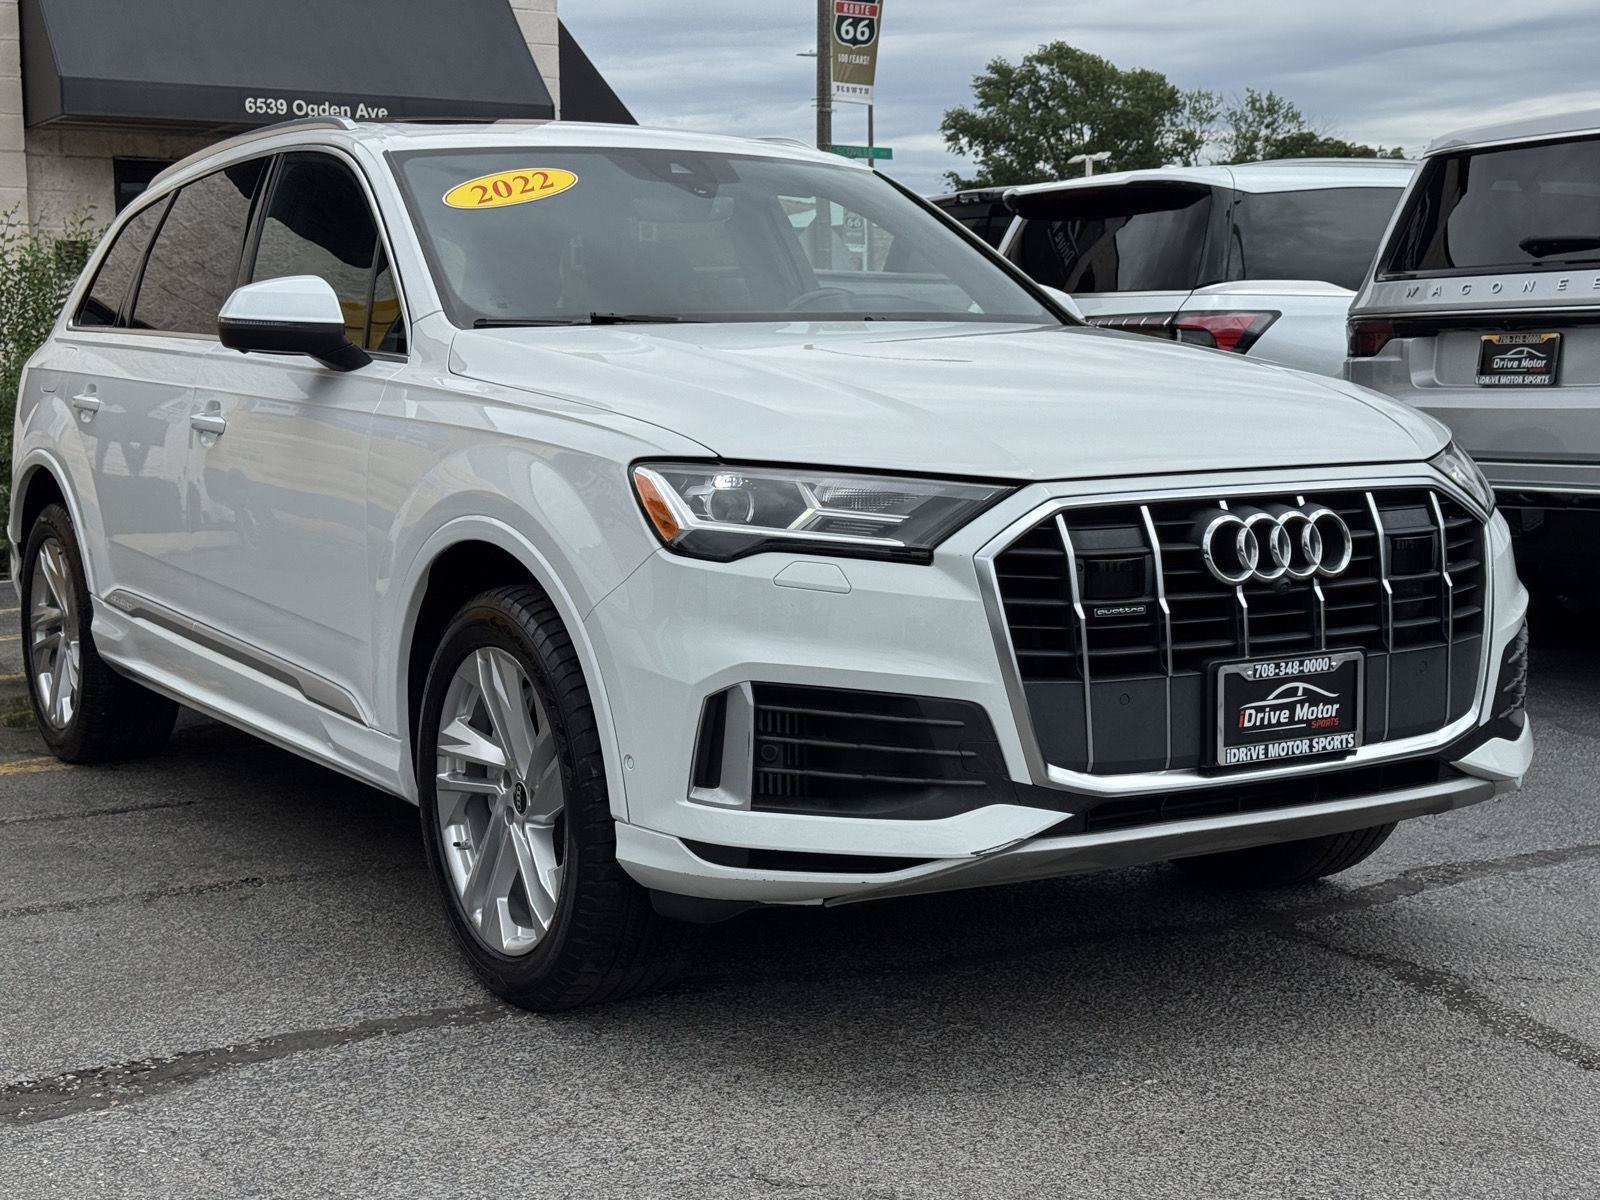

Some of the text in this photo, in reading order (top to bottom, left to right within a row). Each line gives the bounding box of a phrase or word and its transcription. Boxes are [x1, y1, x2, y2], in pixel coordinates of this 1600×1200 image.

[842, 3, 871, 16] ROUTE
[840, 18, 870, 42] 66
[244, 97, 388, 119] 6539 Ogden Ave
[470, 171, 554, 205] 2022
[1520, 357, 1547, 368] Motor
[1097, 606, 1144, 615] quattro
[1255, 657, 1330, 678] 708-348-0000
[1238, 702, 1340, 729] iDrive Motor
[1311, 717, 1340, 729] SPORTS
[1268, 739, 1310, 758] MOTOR
[1312, 733, 1355, 753] SPORTS
